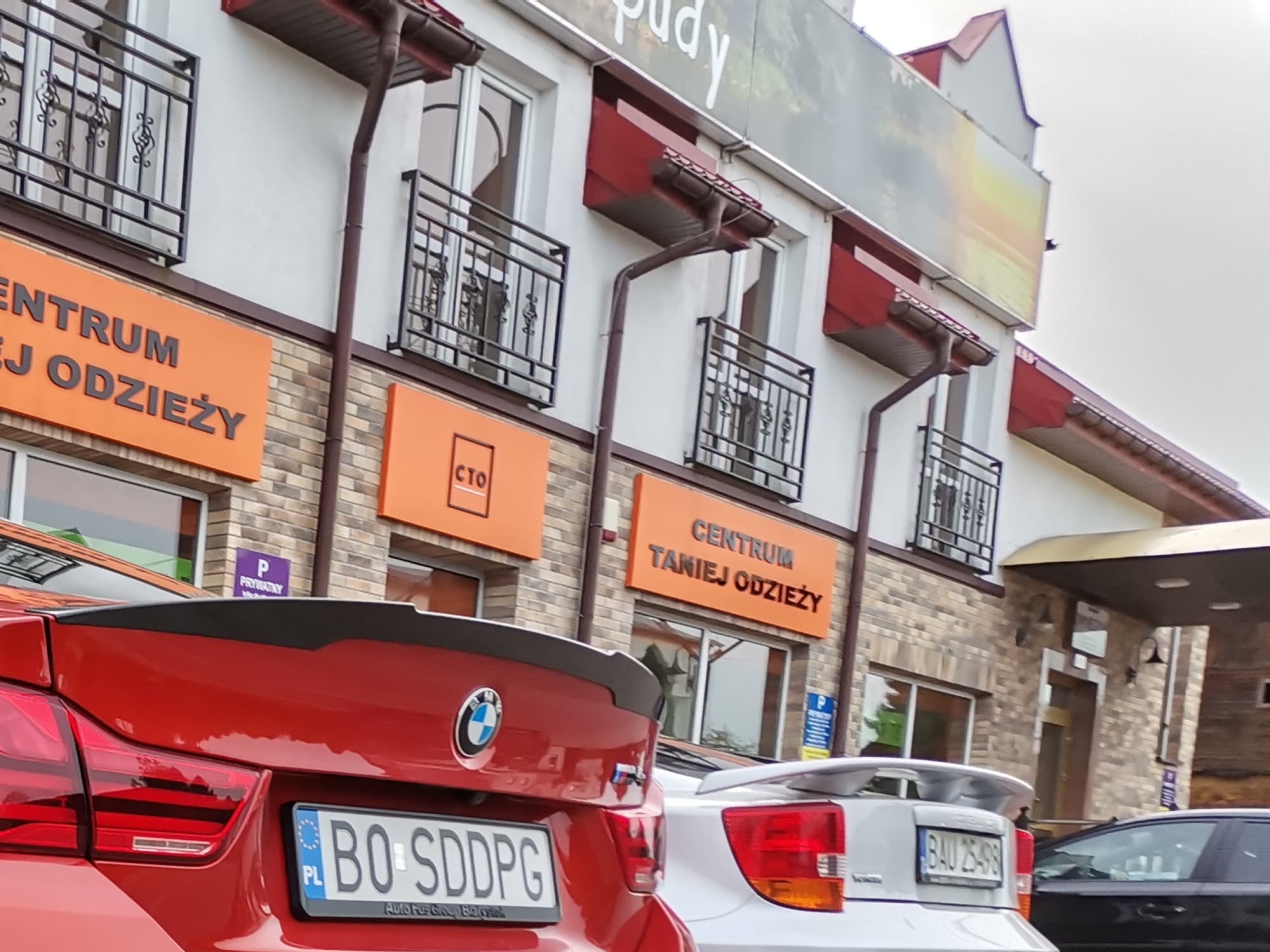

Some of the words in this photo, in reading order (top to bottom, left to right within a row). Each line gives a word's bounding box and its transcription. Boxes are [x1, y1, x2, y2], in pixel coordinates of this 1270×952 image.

[47, 355, 247, 440] ODZIEŻY
[455, 464, 487, 488] CTO
[692, 518, 795, 570] CENTRUM
[257, 558, 270, 578] P
[649, 543, 730, 586] TANIEJ
[734, 570, 823, 613] ODZIEŻY
[817, 695, 826, 710] P
[303, 865, 322, 886] PL
[411, 827, 543, 901] SDDPG
